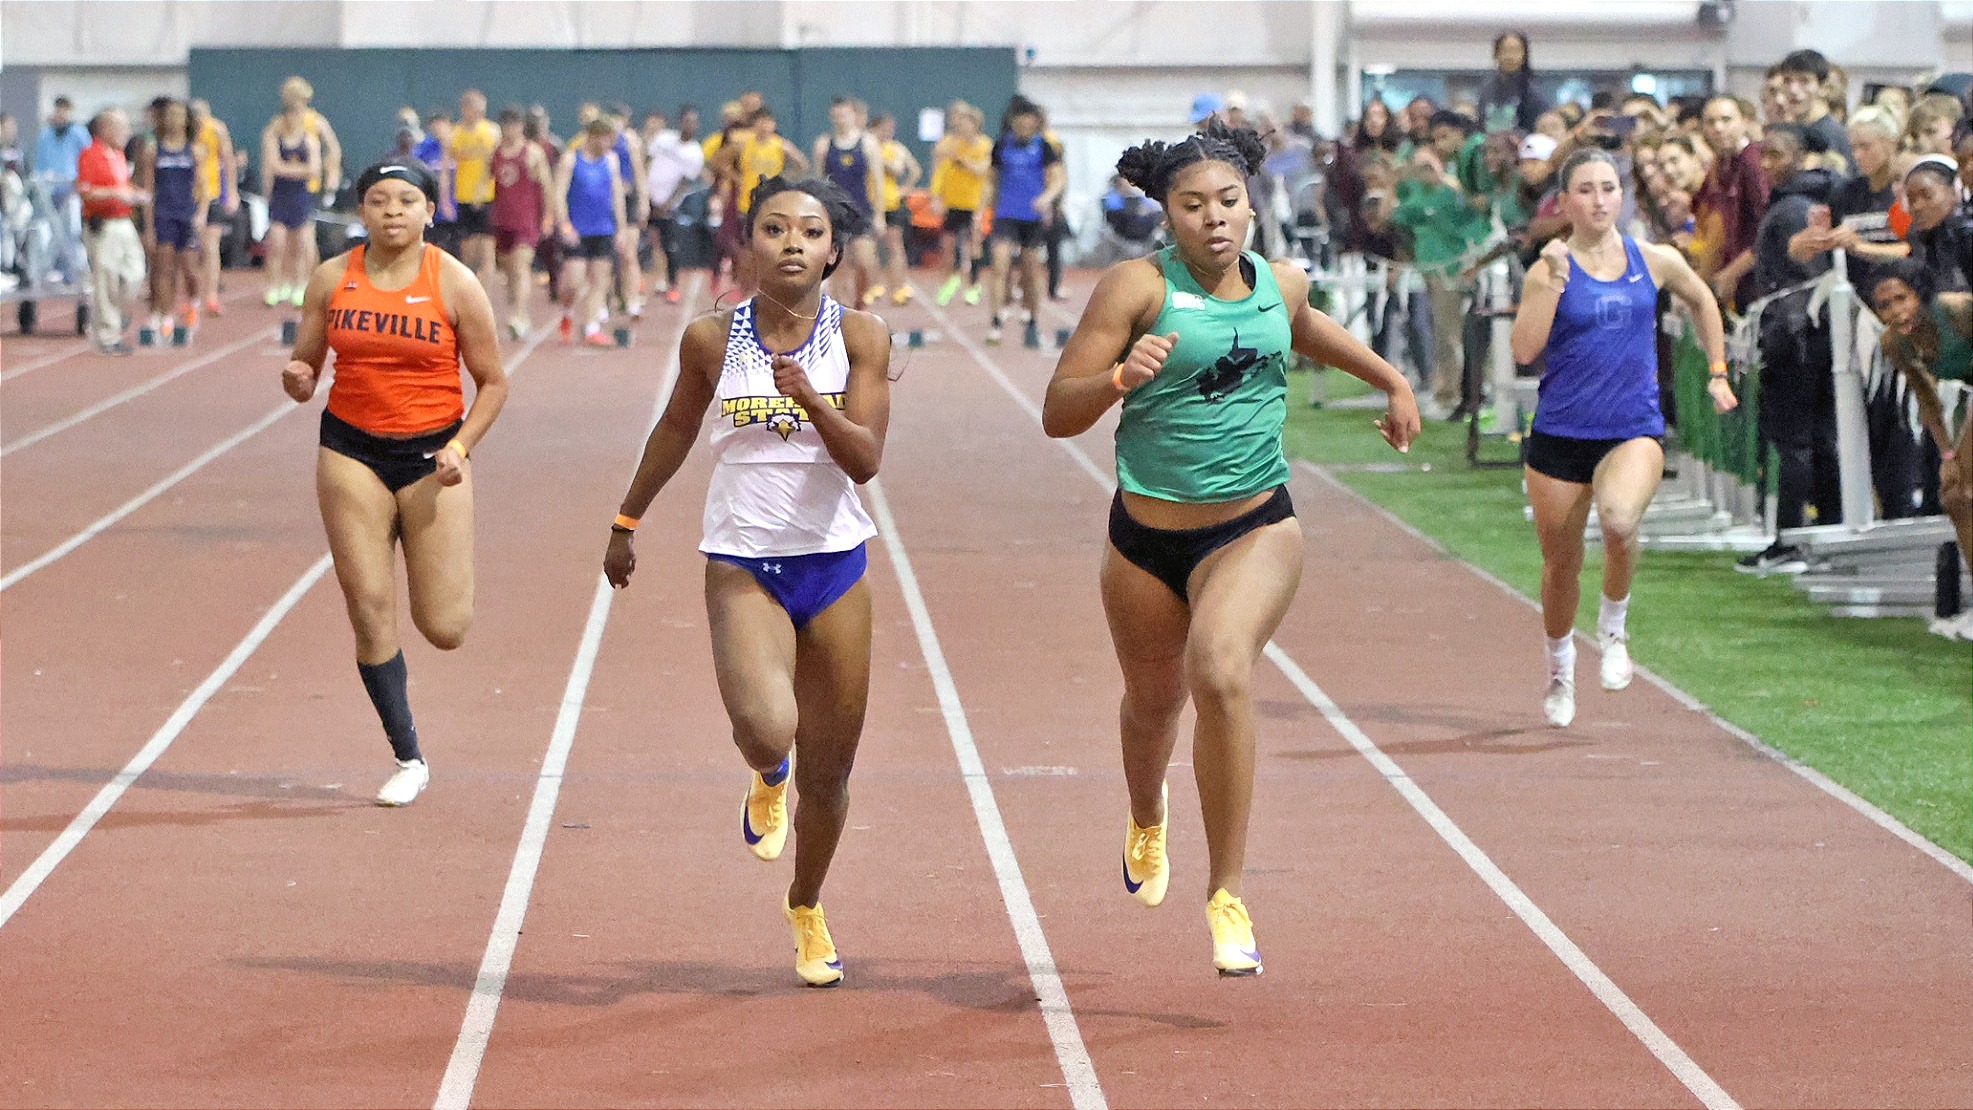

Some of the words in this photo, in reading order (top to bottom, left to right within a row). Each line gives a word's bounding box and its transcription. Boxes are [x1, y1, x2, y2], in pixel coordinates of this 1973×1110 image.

[327, 309, 442, 343] PIKEVILLE
[721, 391, 847, 417] MOREHD
[733, 408, 810, 427] STAT
